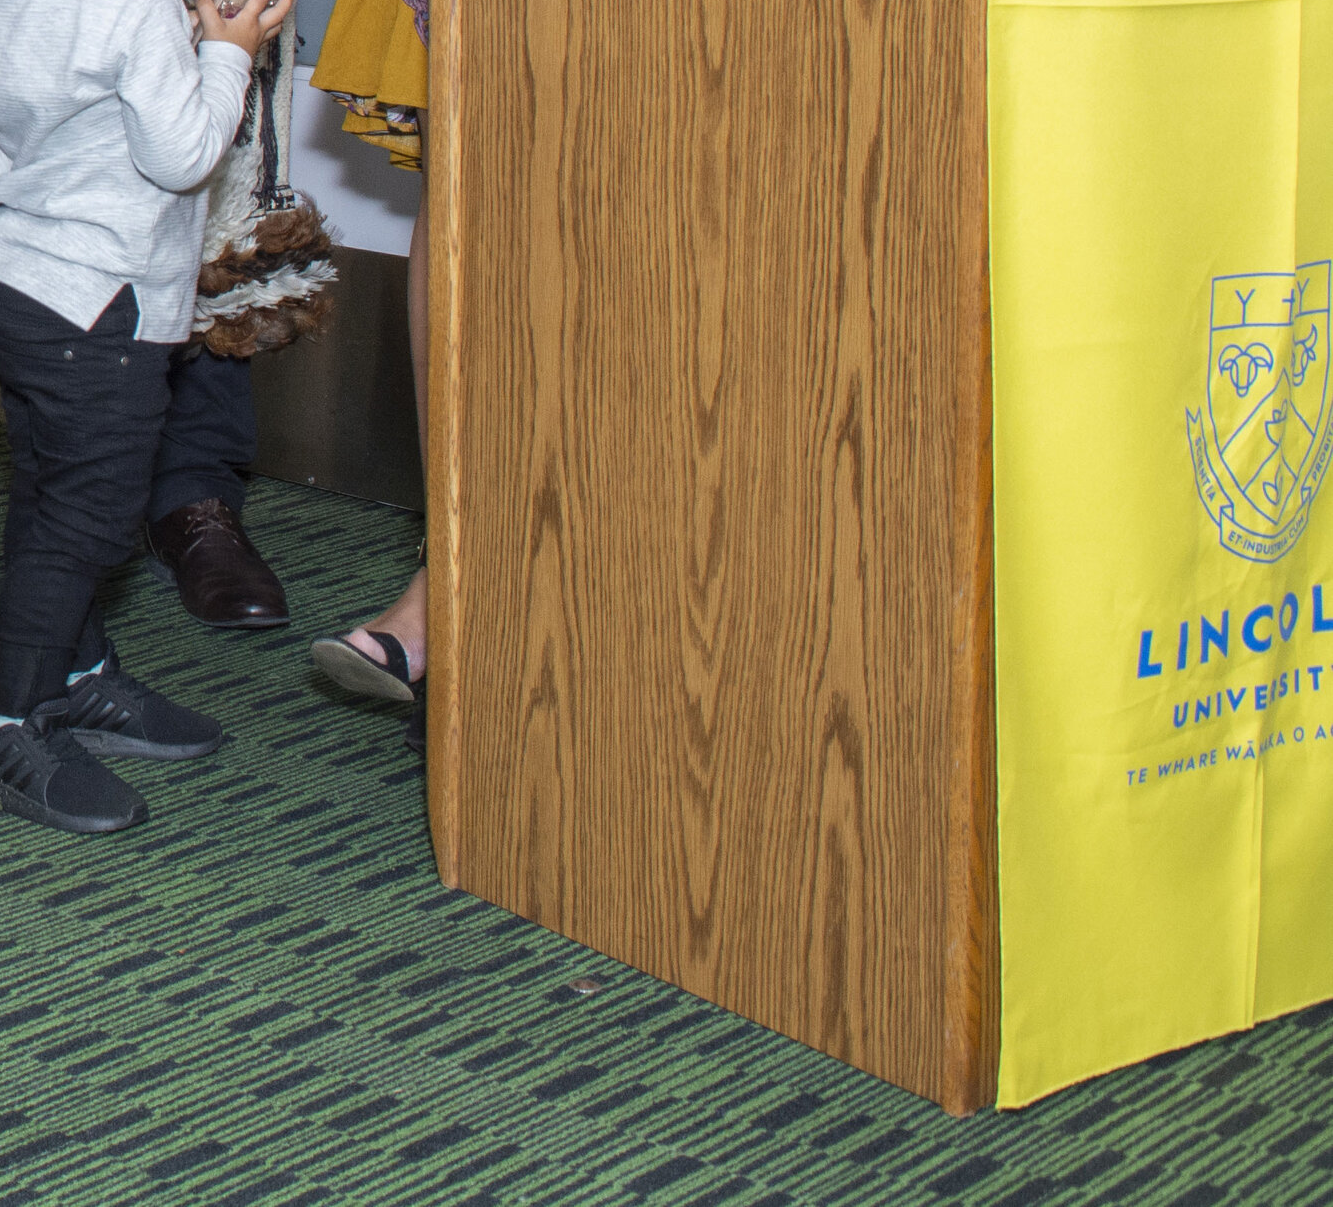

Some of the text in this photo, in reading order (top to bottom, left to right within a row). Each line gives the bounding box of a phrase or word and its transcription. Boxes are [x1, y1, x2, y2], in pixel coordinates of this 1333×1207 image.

[1127, 767, 1148, 786] TE
[1157, 749, 1217, 778] WHARE
[1293, 726, 1305, 743] O
